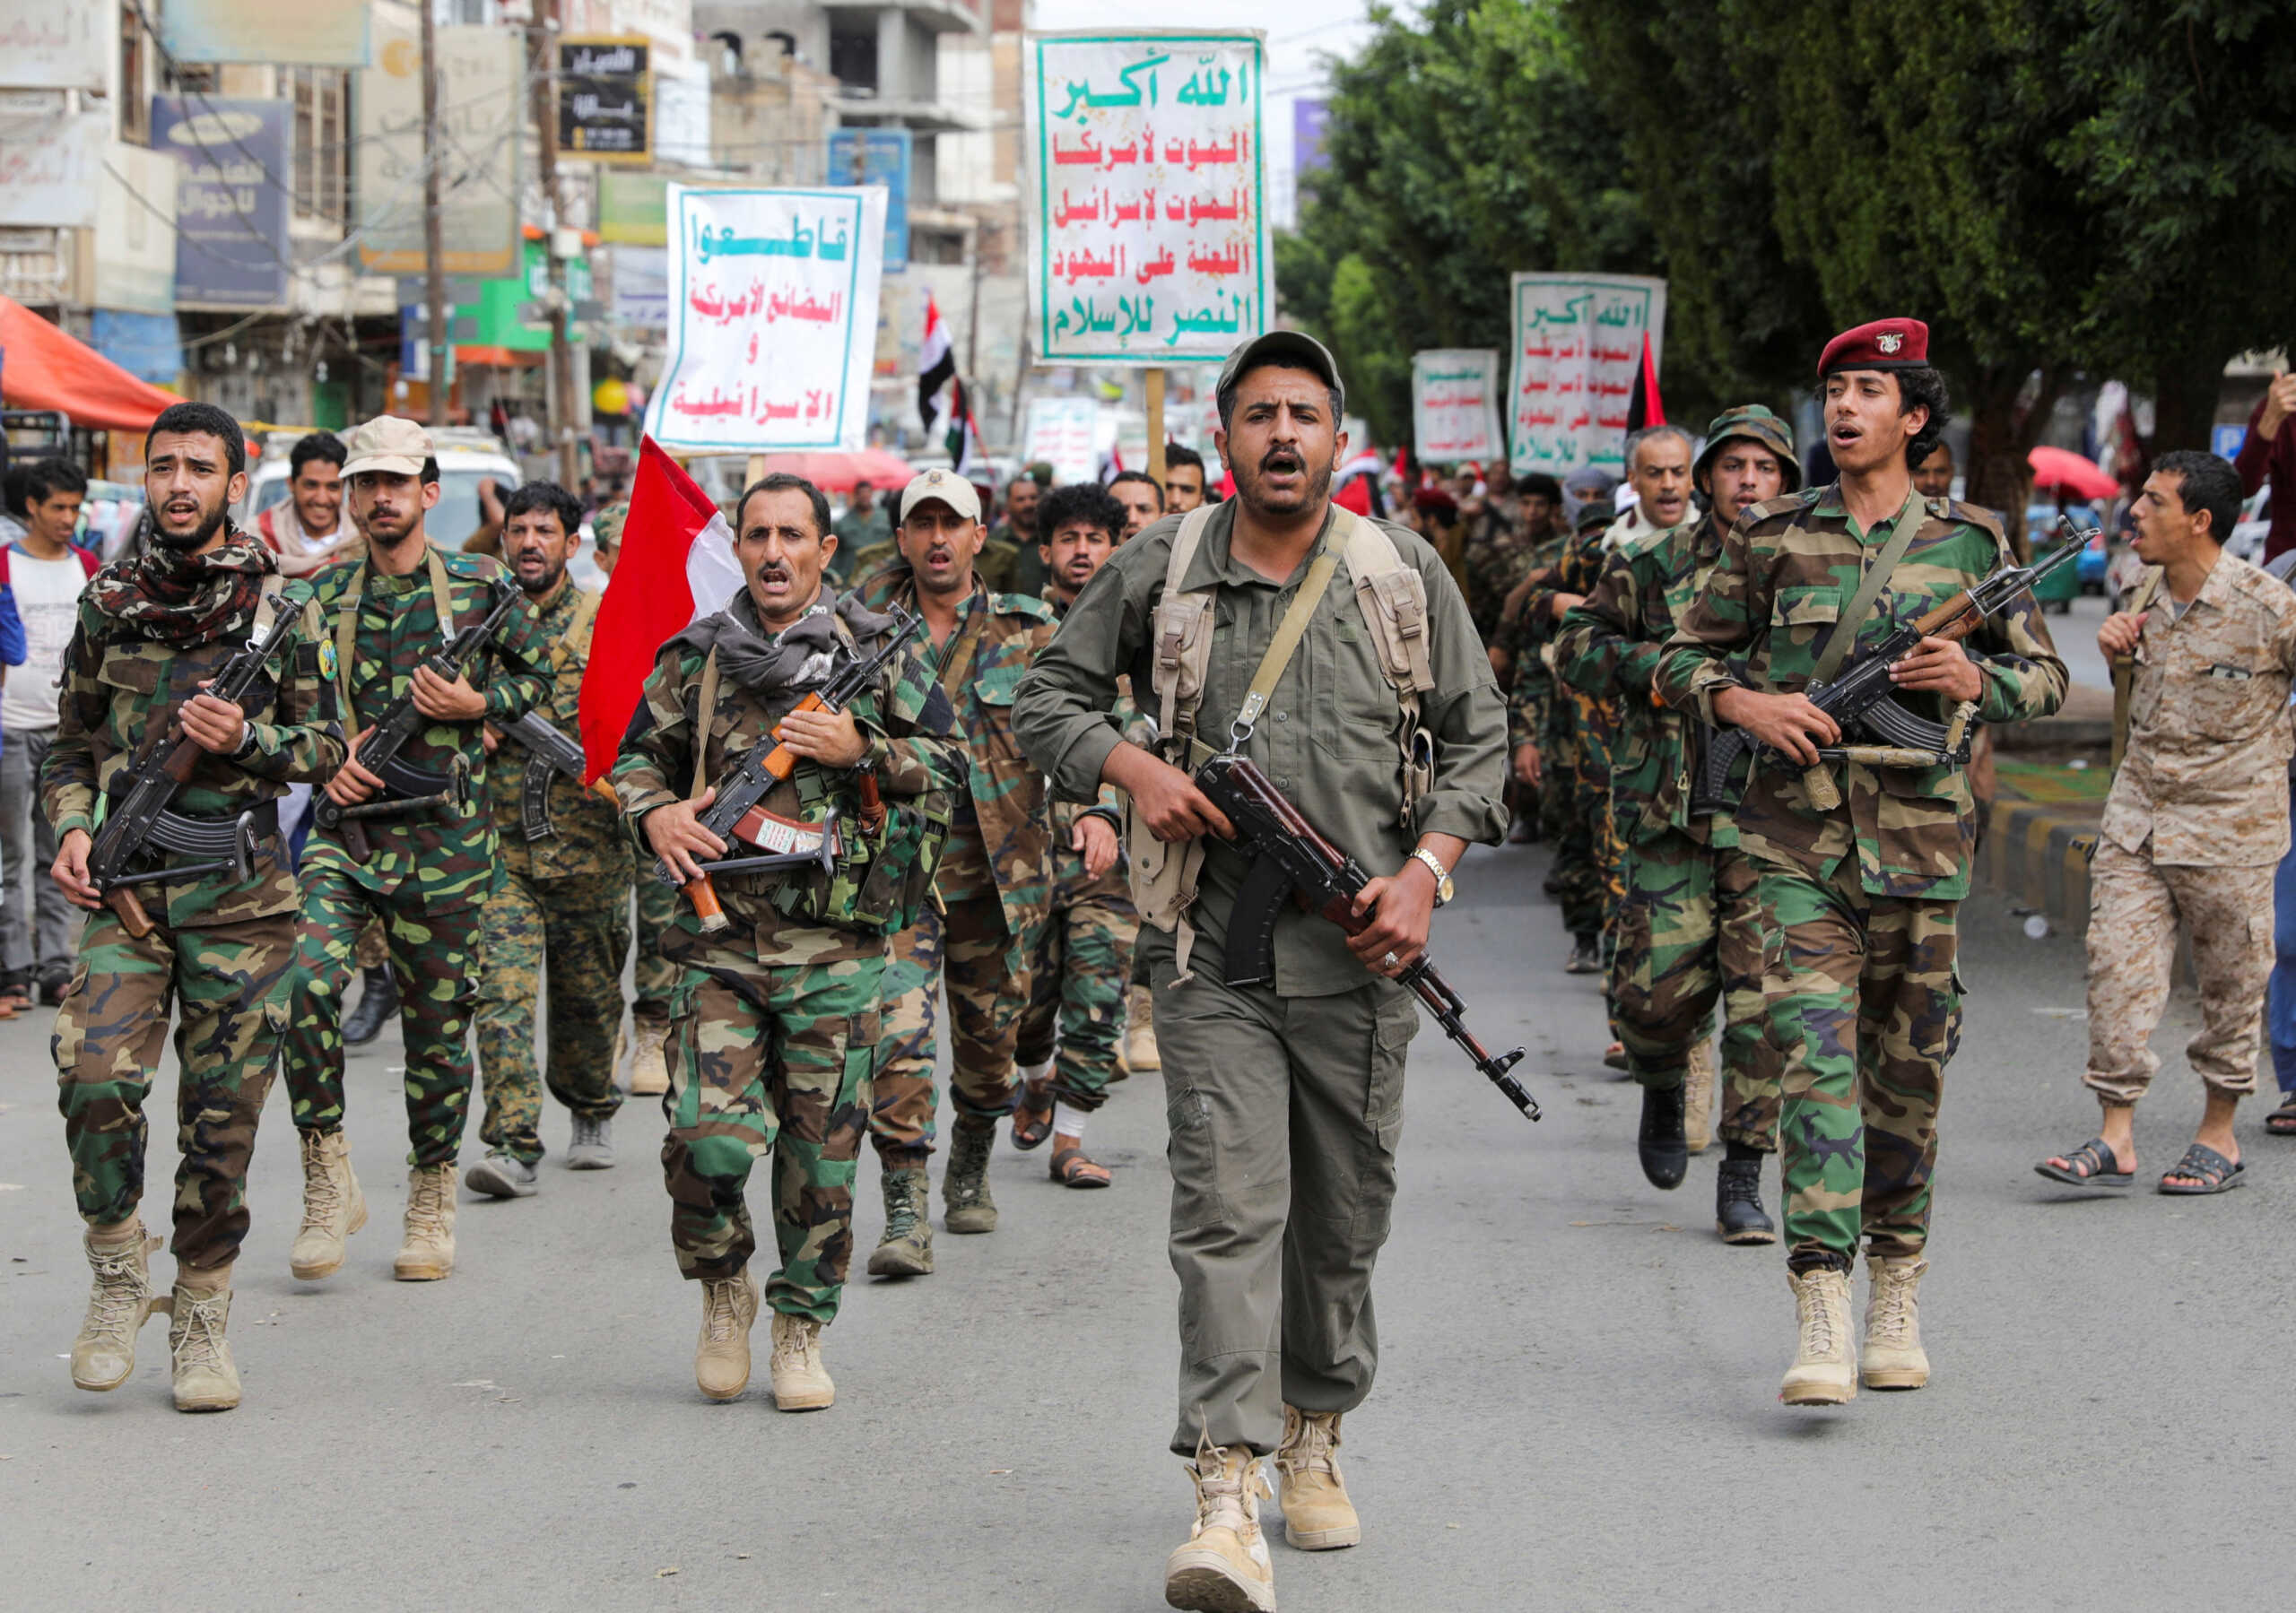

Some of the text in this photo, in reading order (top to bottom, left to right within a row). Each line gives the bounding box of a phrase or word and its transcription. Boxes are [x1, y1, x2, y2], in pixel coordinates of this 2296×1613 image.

[1051, 46, 1248, 126] الله أكبر
[1053, 123, 1248, 172] الموت لأمريكا
[1054, 185, 1248, 230] الموت لإسرائيل
[691, 212, 847, 264] قاطعوا
[1054, 240, 1249, 285] اللعنة على اليهود
[767, 282, 841, 330] البضائع
[1055, 287, 1251, 349] النصر للإسلام
[747, 332, 759, 364] و
[673, 380, 832, 426] الإسرائيلية
